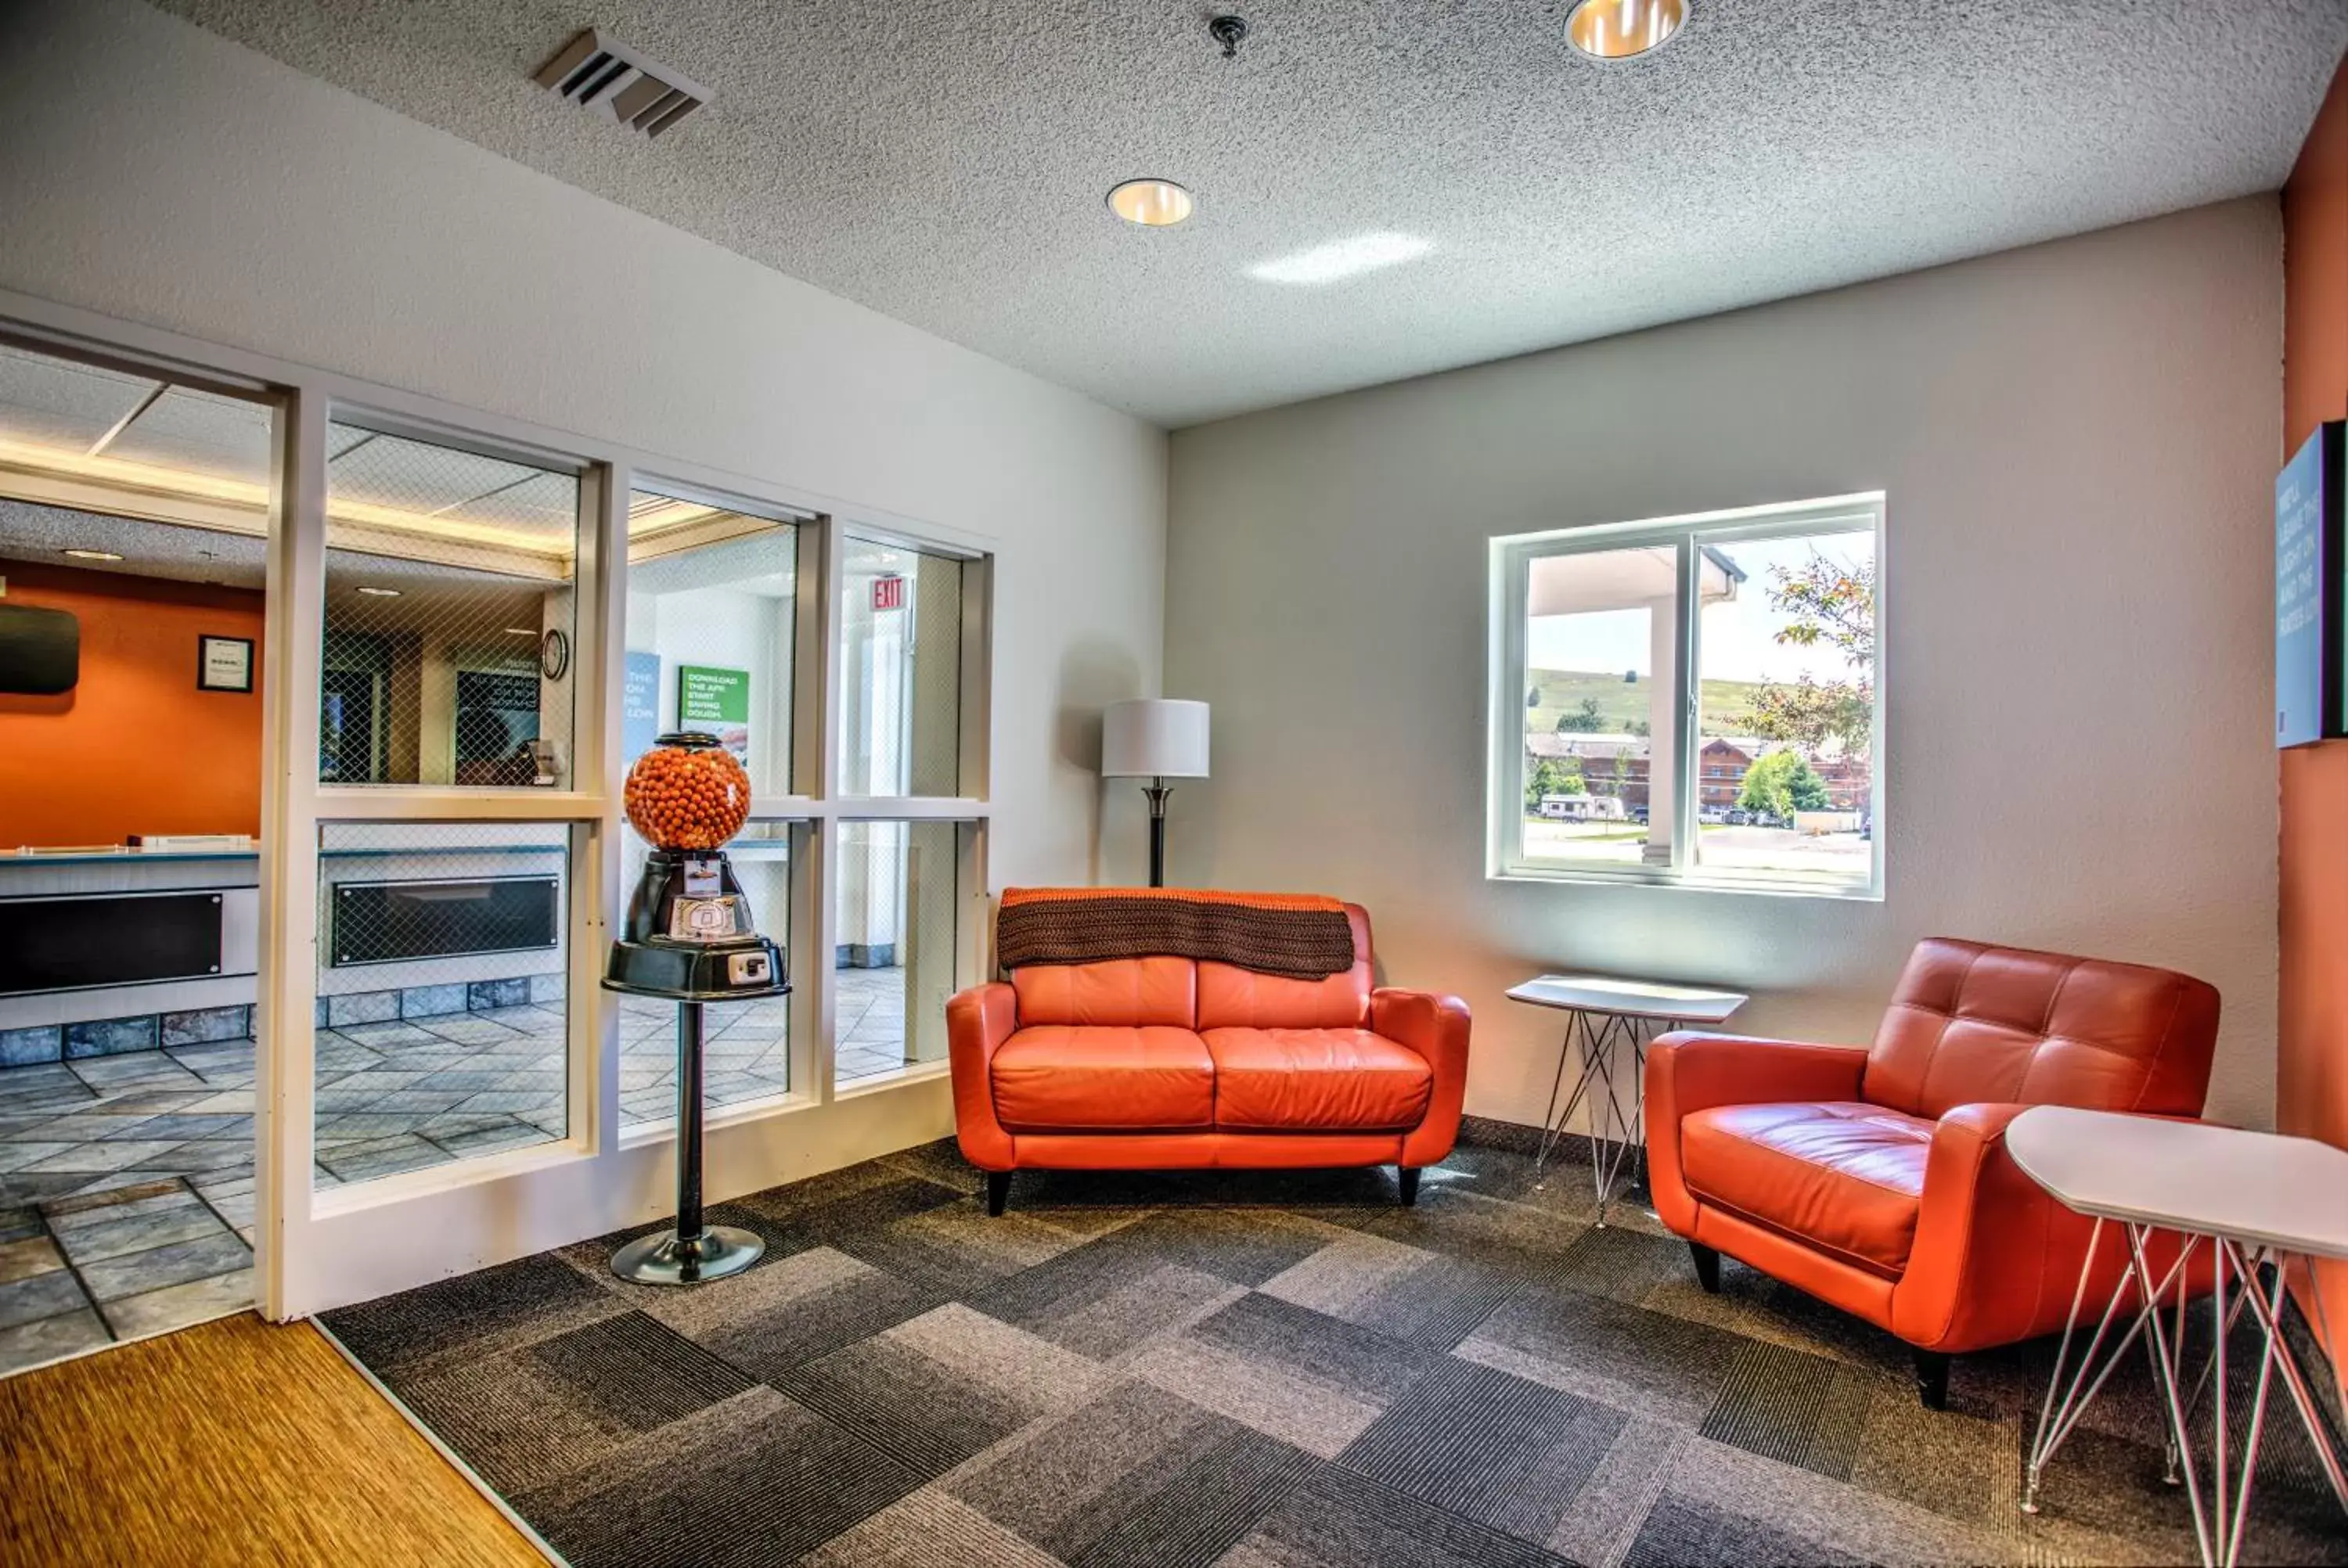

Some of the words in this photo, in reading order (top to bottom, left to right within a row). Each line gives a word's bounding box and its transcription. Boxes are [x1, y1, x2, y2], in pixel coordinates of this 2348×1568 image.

[875, 579, 902, 608] EXIT
[689, 674, 738, 685] DOWNLOAD
[689, 682, 705, 691] THE
[688, 692, 714, 700] START
